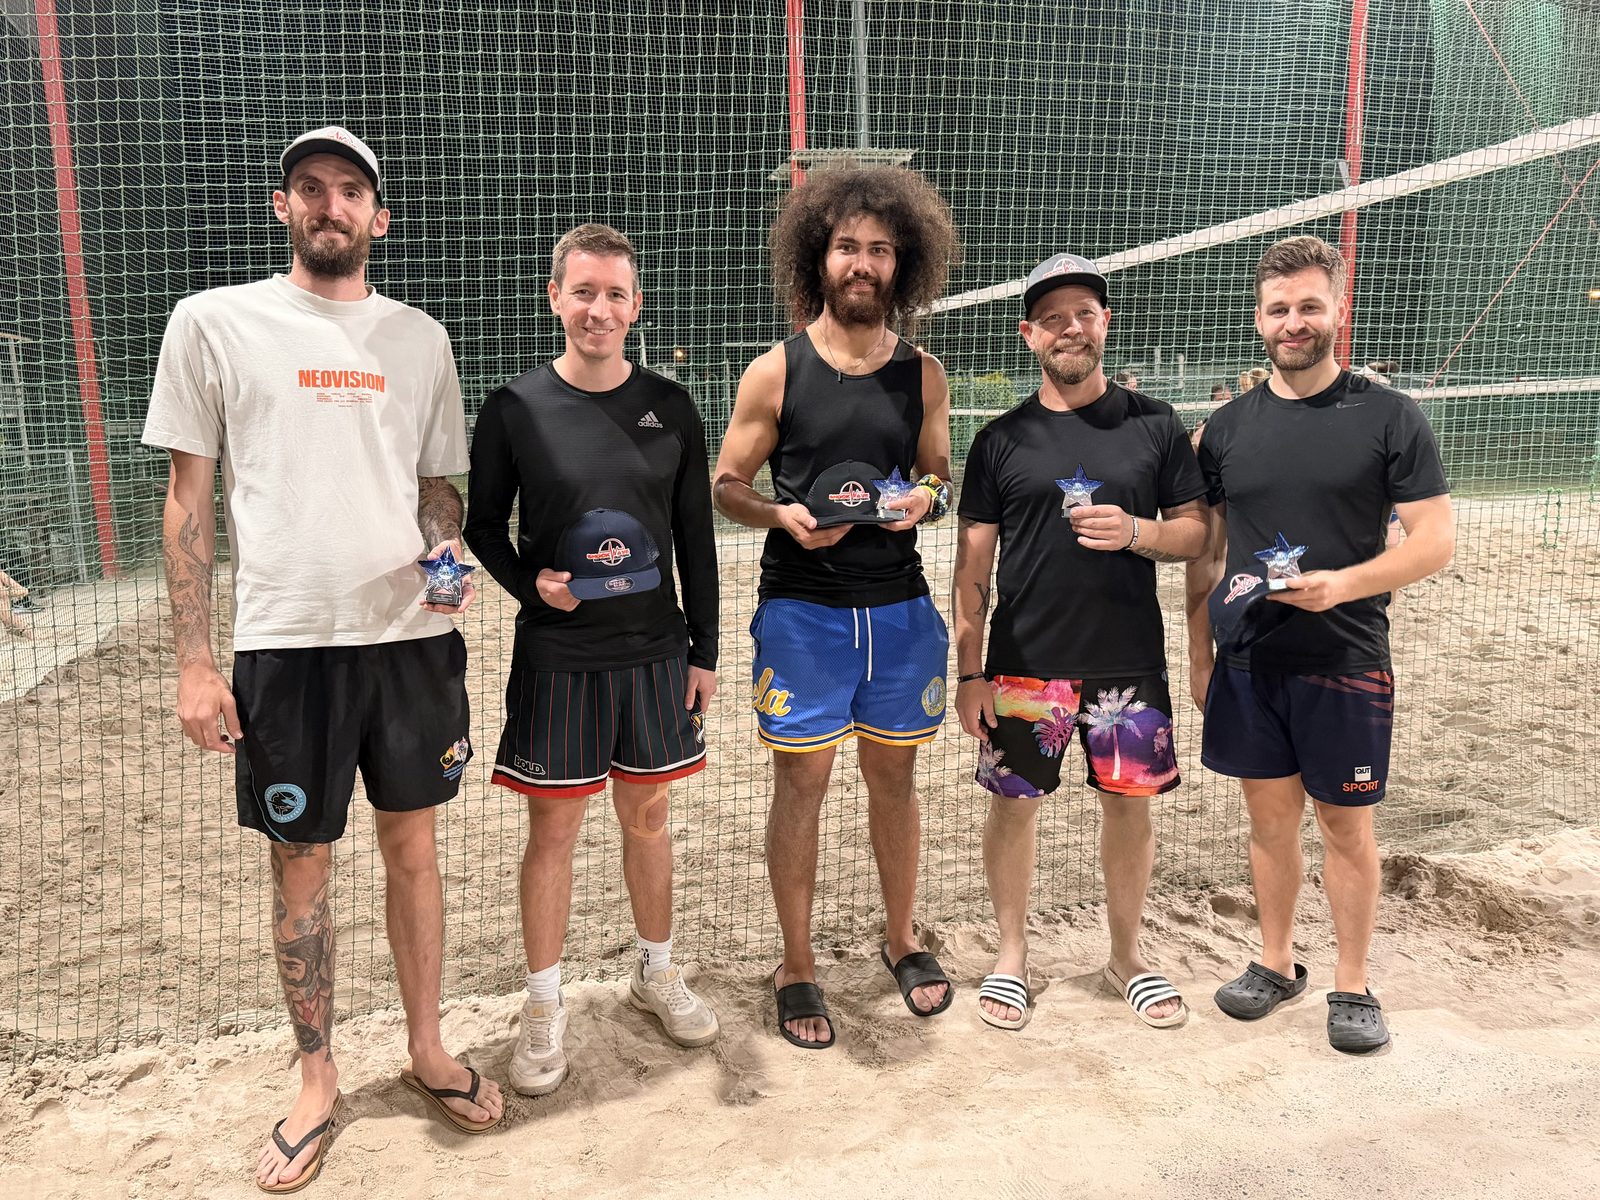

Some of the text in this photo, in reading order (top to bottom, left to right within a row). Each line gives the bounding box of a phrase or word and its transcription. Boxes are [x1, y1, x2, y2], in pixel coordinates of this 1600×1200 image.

[298, 369, 385, 393] NEOVISION
[638, 420, 663, 428] adidas
[1343, 780, 1379, 792] SPORT
